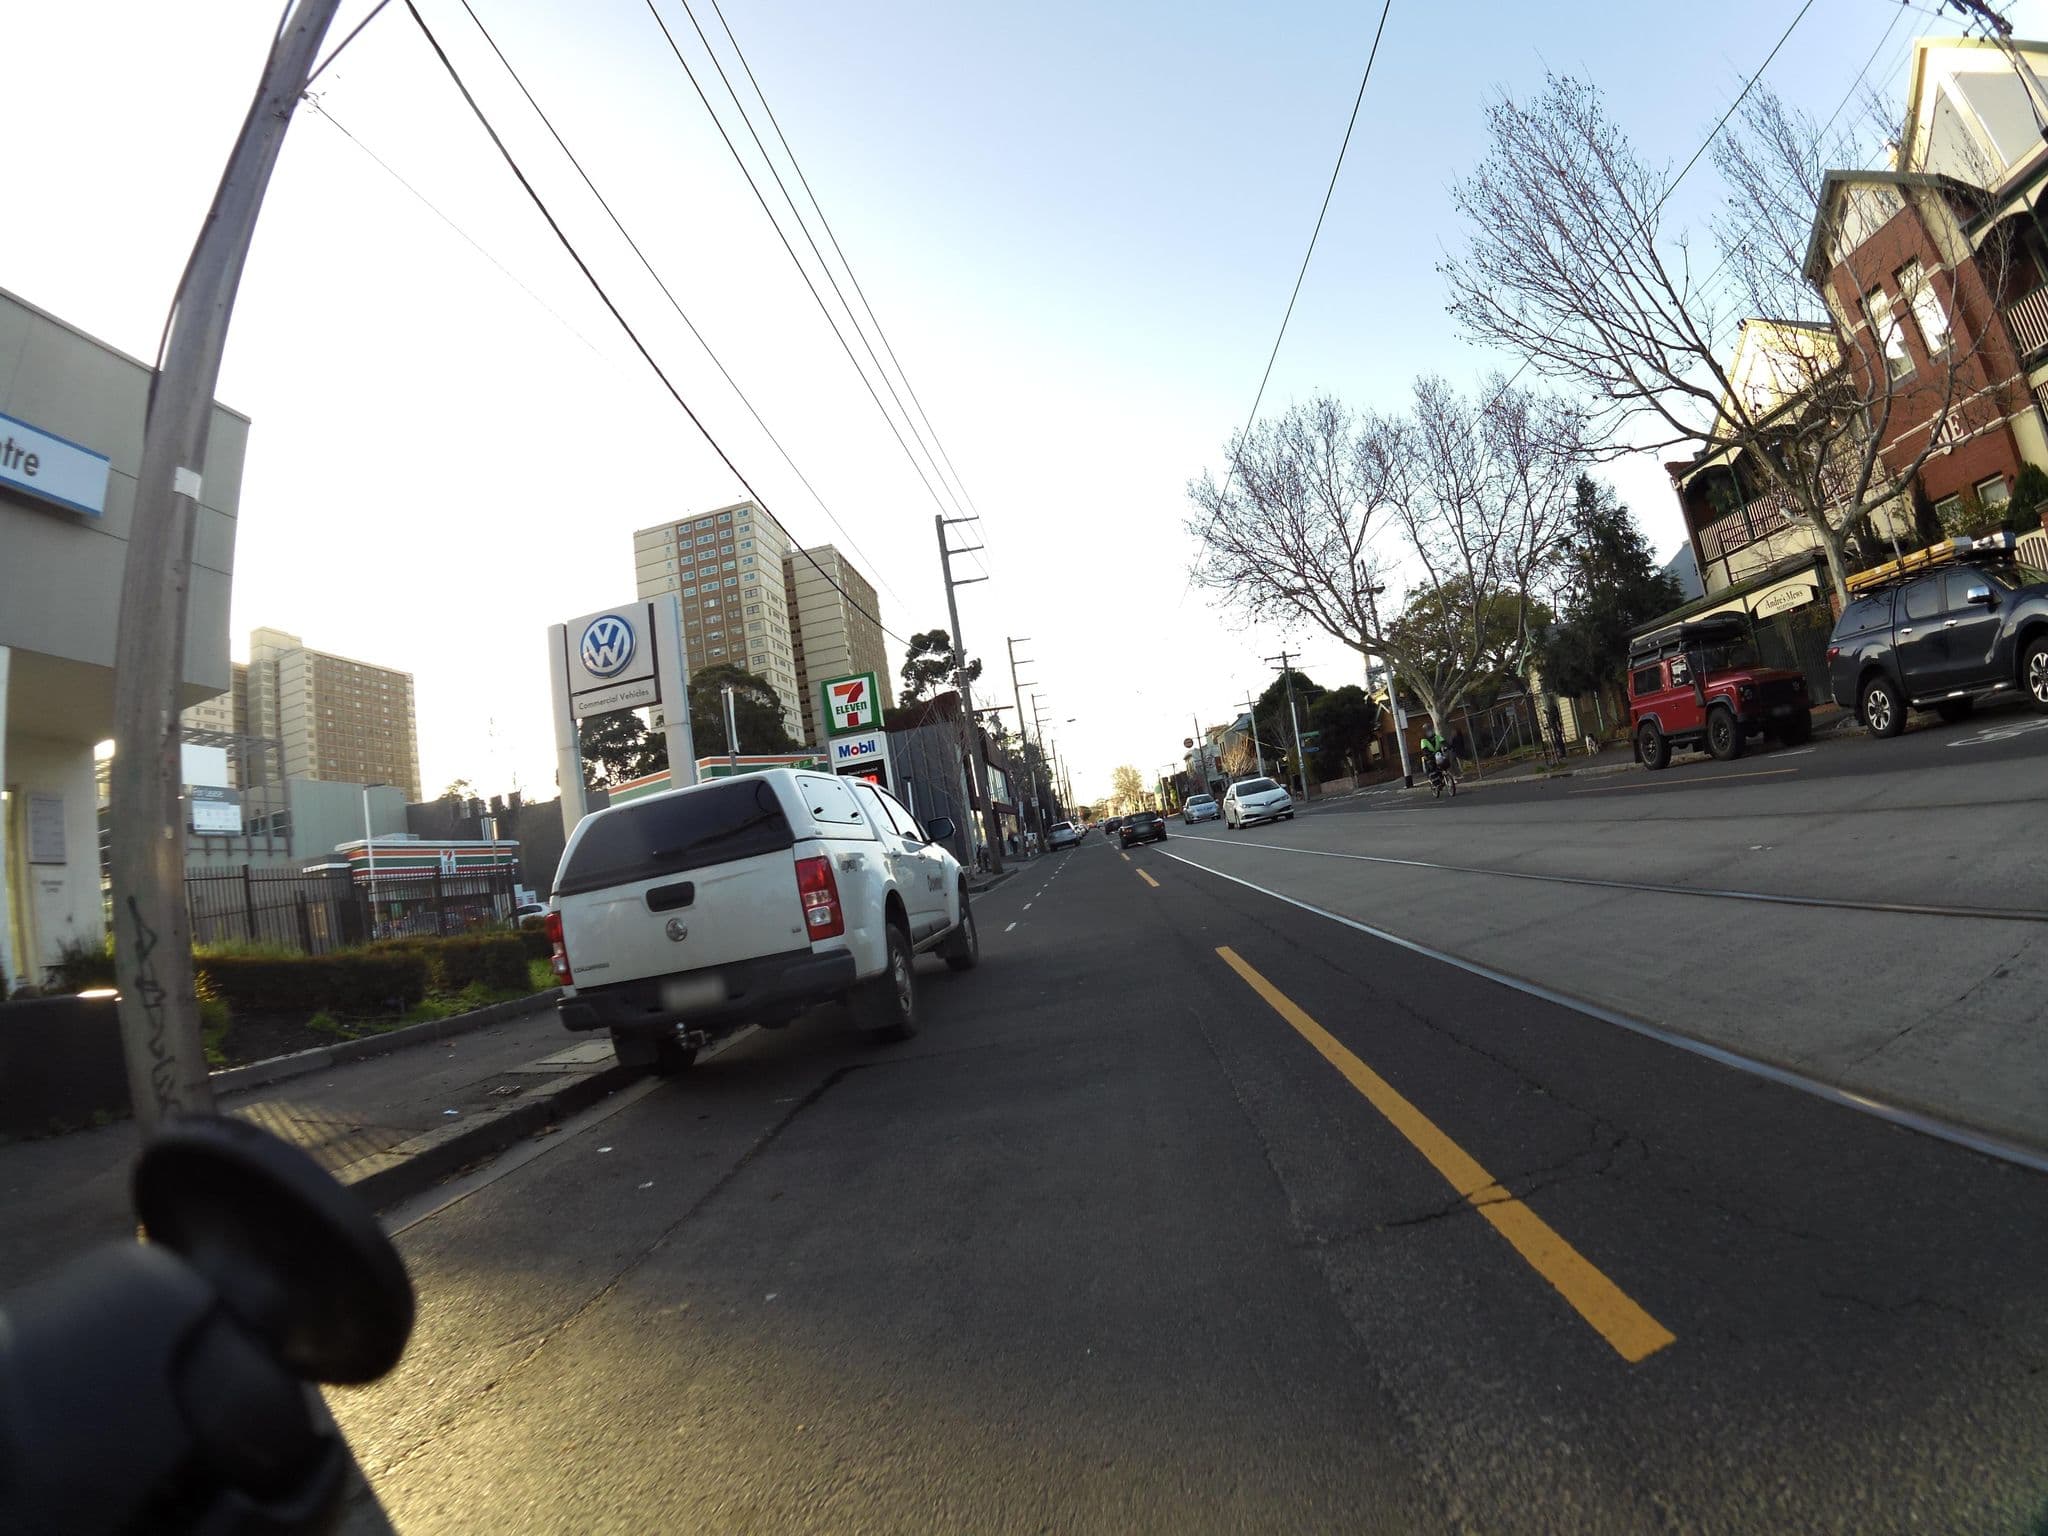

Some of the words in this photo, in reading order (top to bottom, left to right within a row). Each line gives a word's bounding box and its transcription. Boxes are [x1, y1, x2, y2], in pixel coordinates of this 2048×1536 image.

[0, 437, 39, 477] tre
[579, 693, 618, 710] Commercial
[619, 688, 650, 701] Vehicles
[838, 740, 876, 758] Mobil
